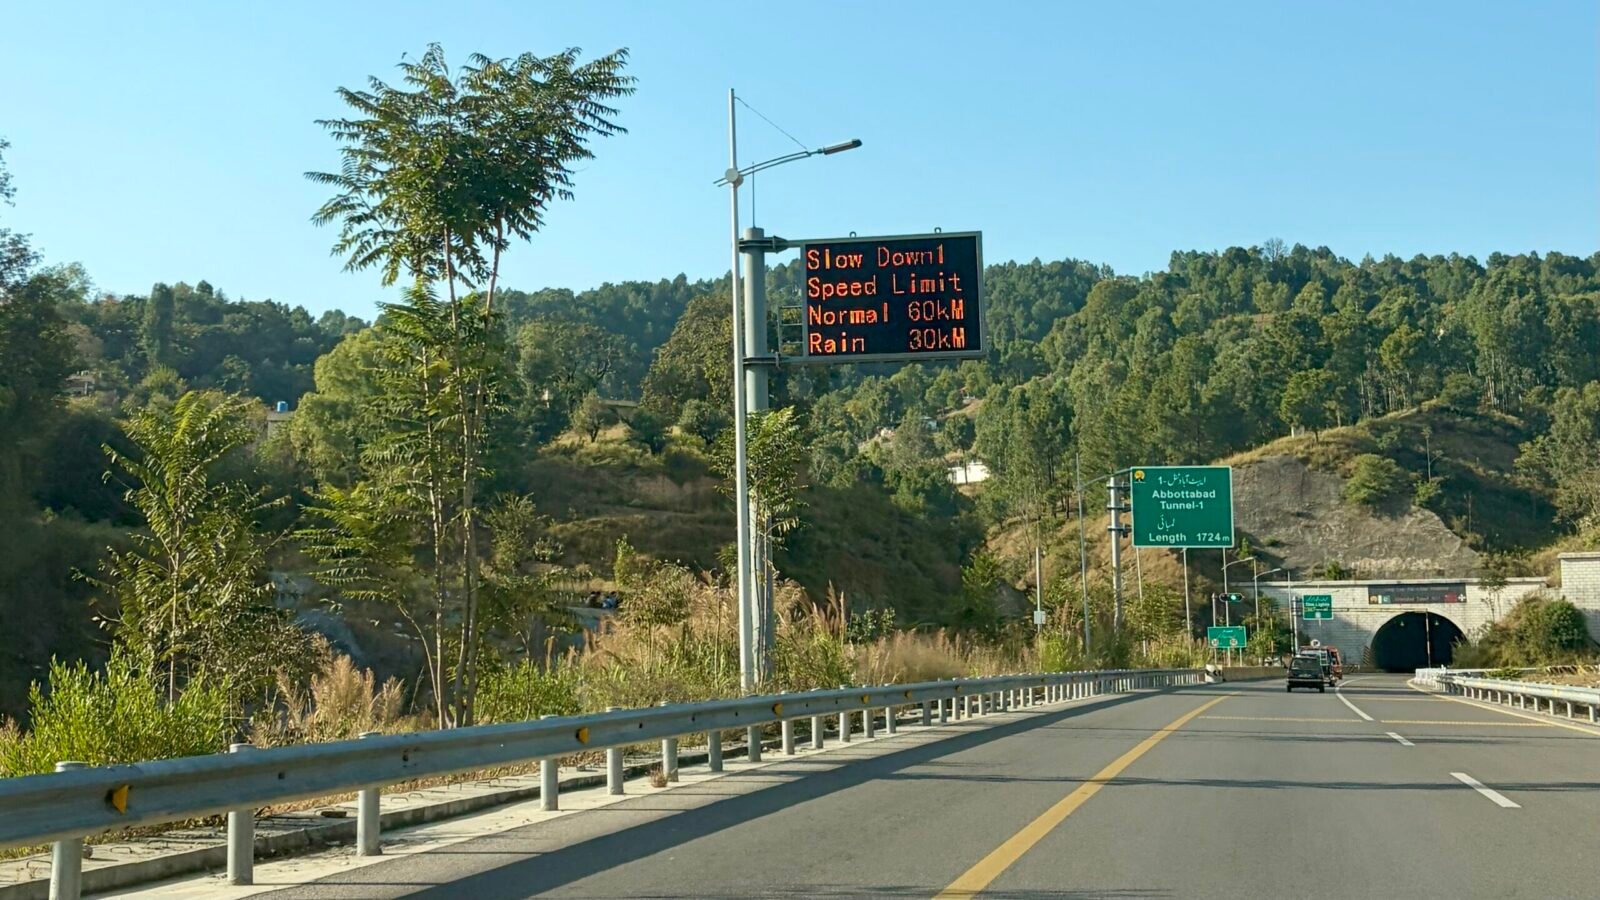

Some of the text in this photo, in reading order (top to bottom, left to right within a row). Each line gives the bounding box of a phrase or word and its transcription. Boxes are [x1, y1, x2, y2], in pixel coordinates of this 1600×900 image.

[807, 249, 863, 270] Slow
[807, 271, 963, 301] Speed Limit
[808, 299, 965, 326] Normal 60kM
[809, 327, 966, 354] Rain 30kM
[1152, 489, 1216, 499] Abbottabad
[1159, 501, 1204, 510] Tunnel-1
[1148, 533, 1187, 544] Length
[1196, 532, 1221, 542] 1724
